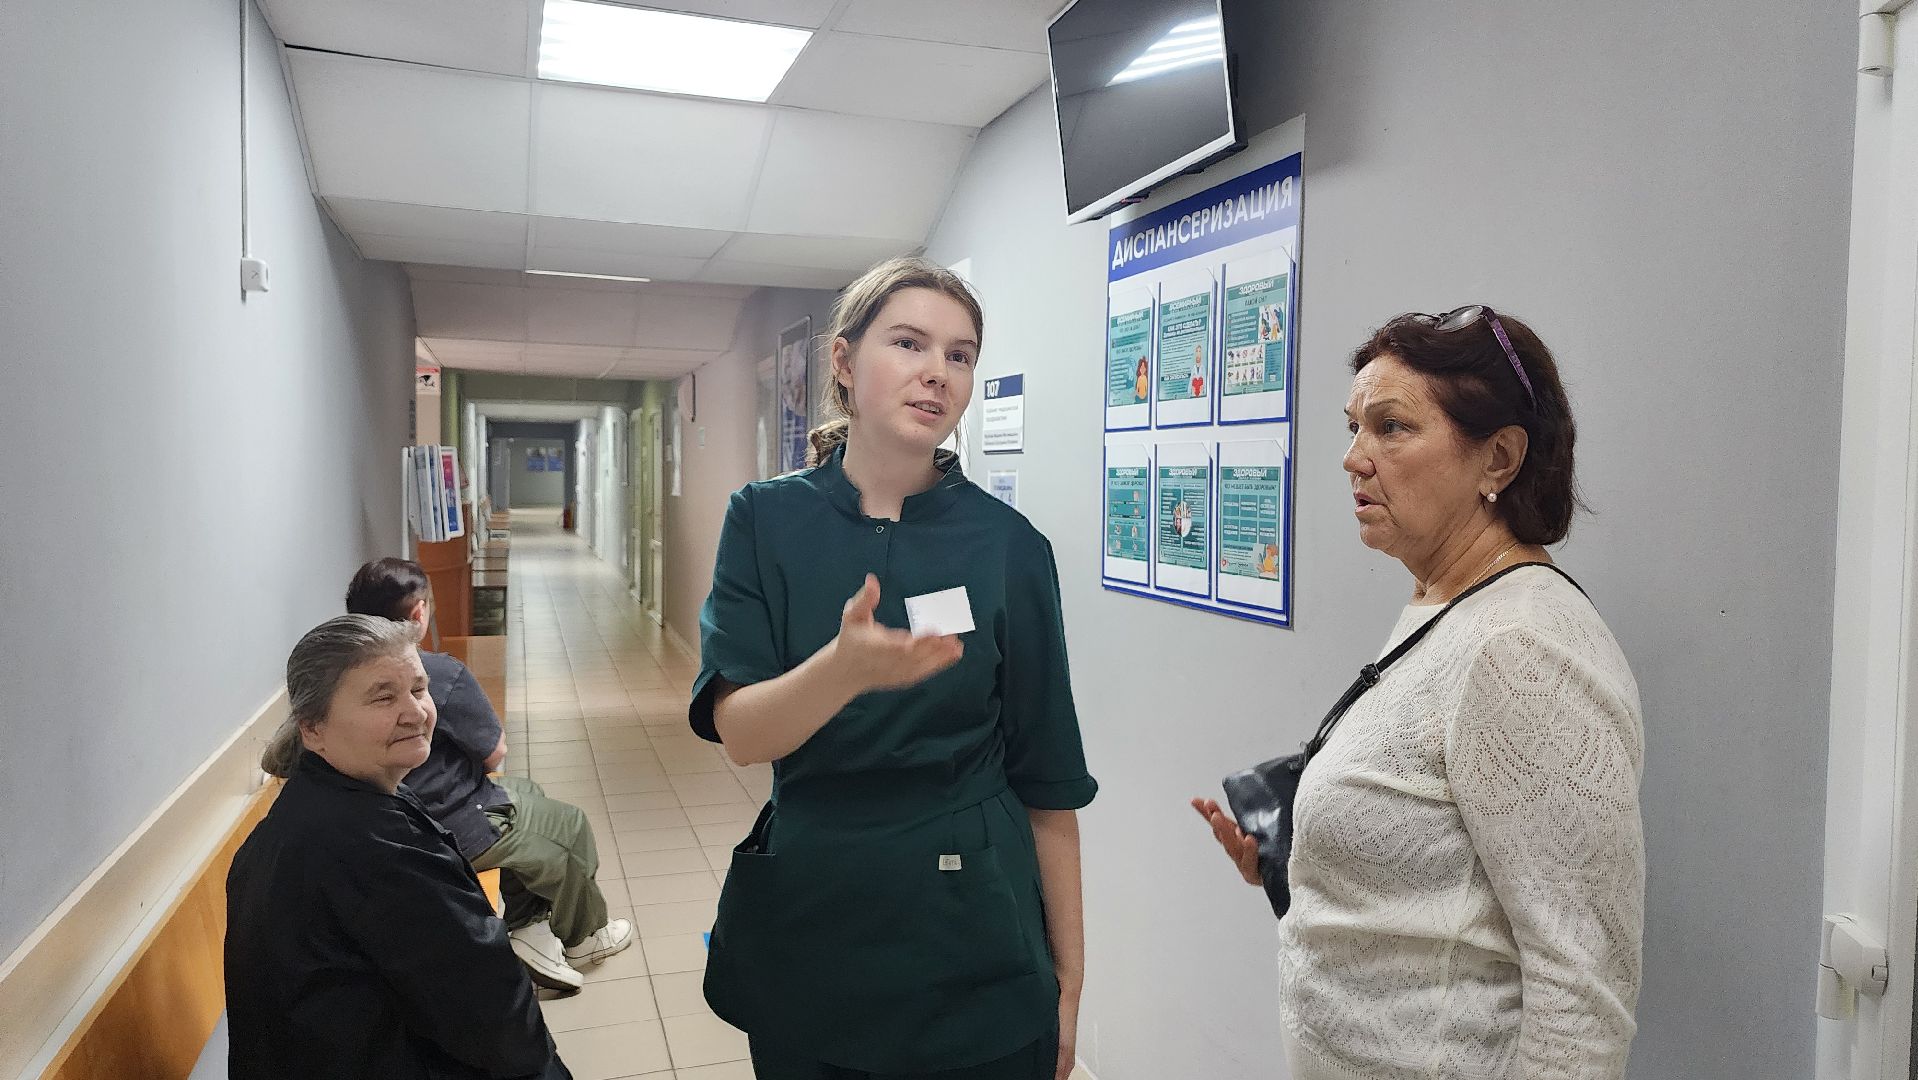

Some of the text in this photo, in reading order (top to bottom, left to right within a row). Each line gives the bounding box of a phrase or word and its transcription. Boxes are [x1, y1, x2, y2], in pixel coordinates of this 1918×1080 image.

[1111, 175, 1293, 271] ДИСПАНСЕРИЗАЦИЯ
[986, 380, 1000, 398] 107
[1232, 468, 1268, 477] ЗДОРОВЫЙ
